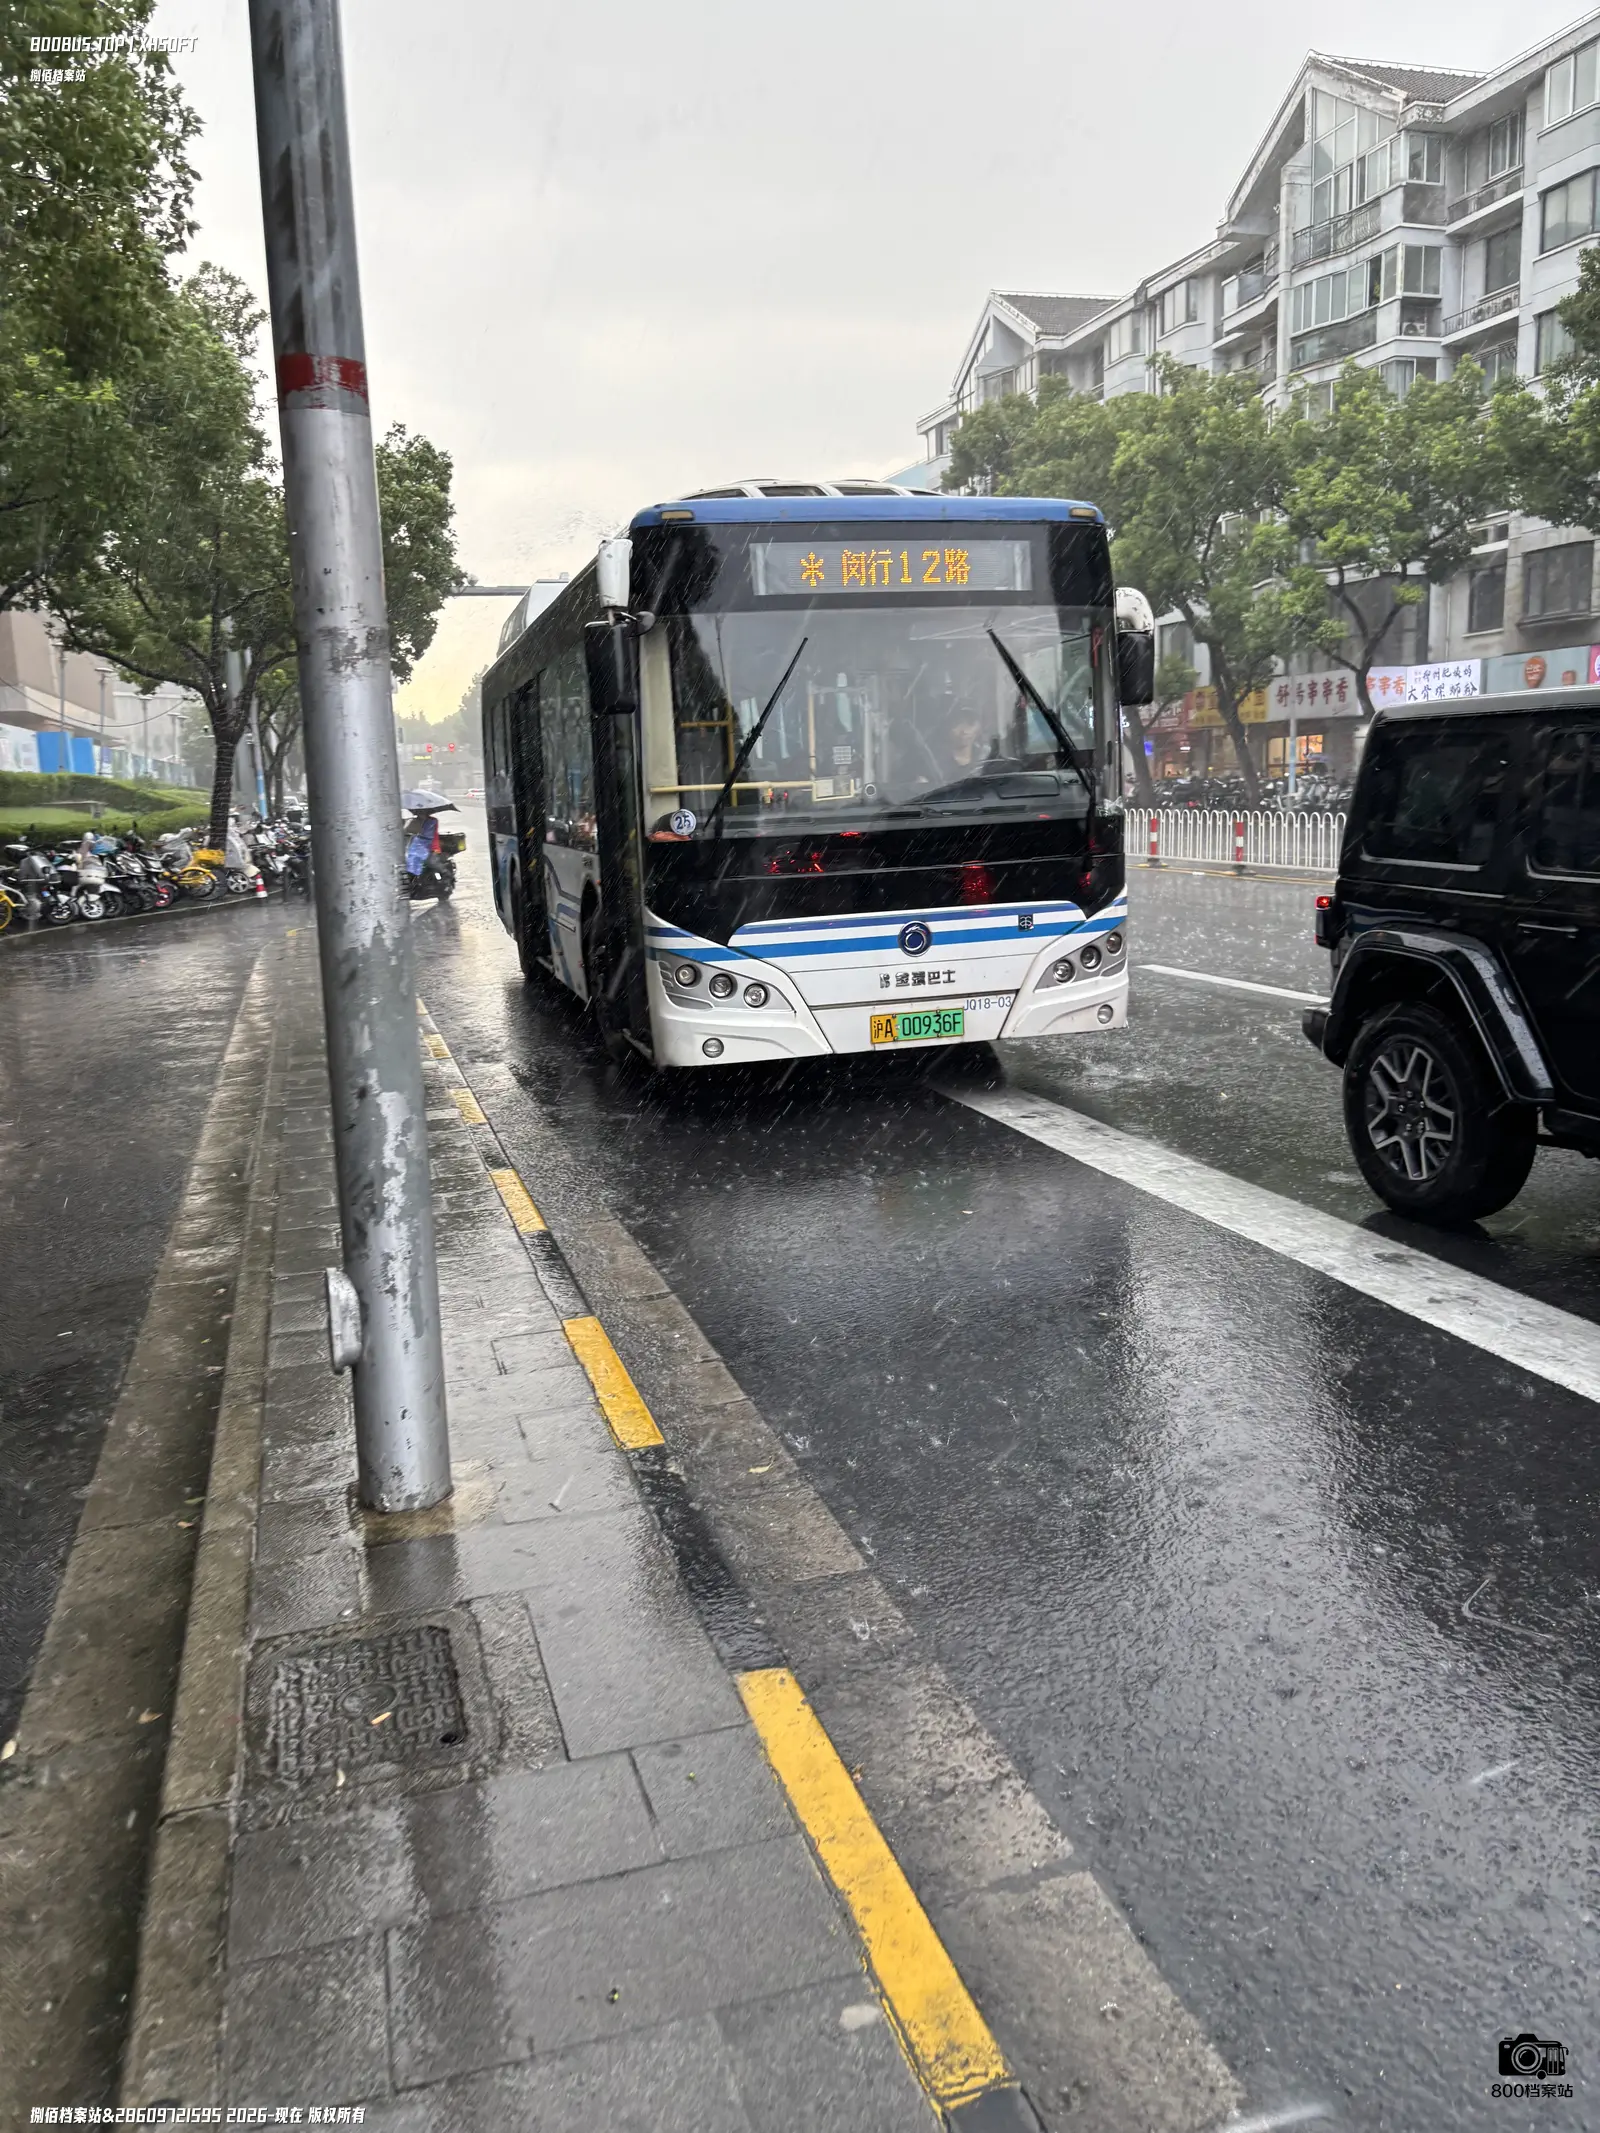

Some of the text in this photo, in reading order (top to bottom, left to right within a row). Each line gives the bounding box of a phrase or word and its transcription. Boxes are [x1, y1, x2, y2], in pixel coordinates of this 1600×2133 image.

[841, 549, 971, 586] 闵行12路
[675, 812, 691, 830] 25
[963, 996, 1012, 1010] JQ18-03
